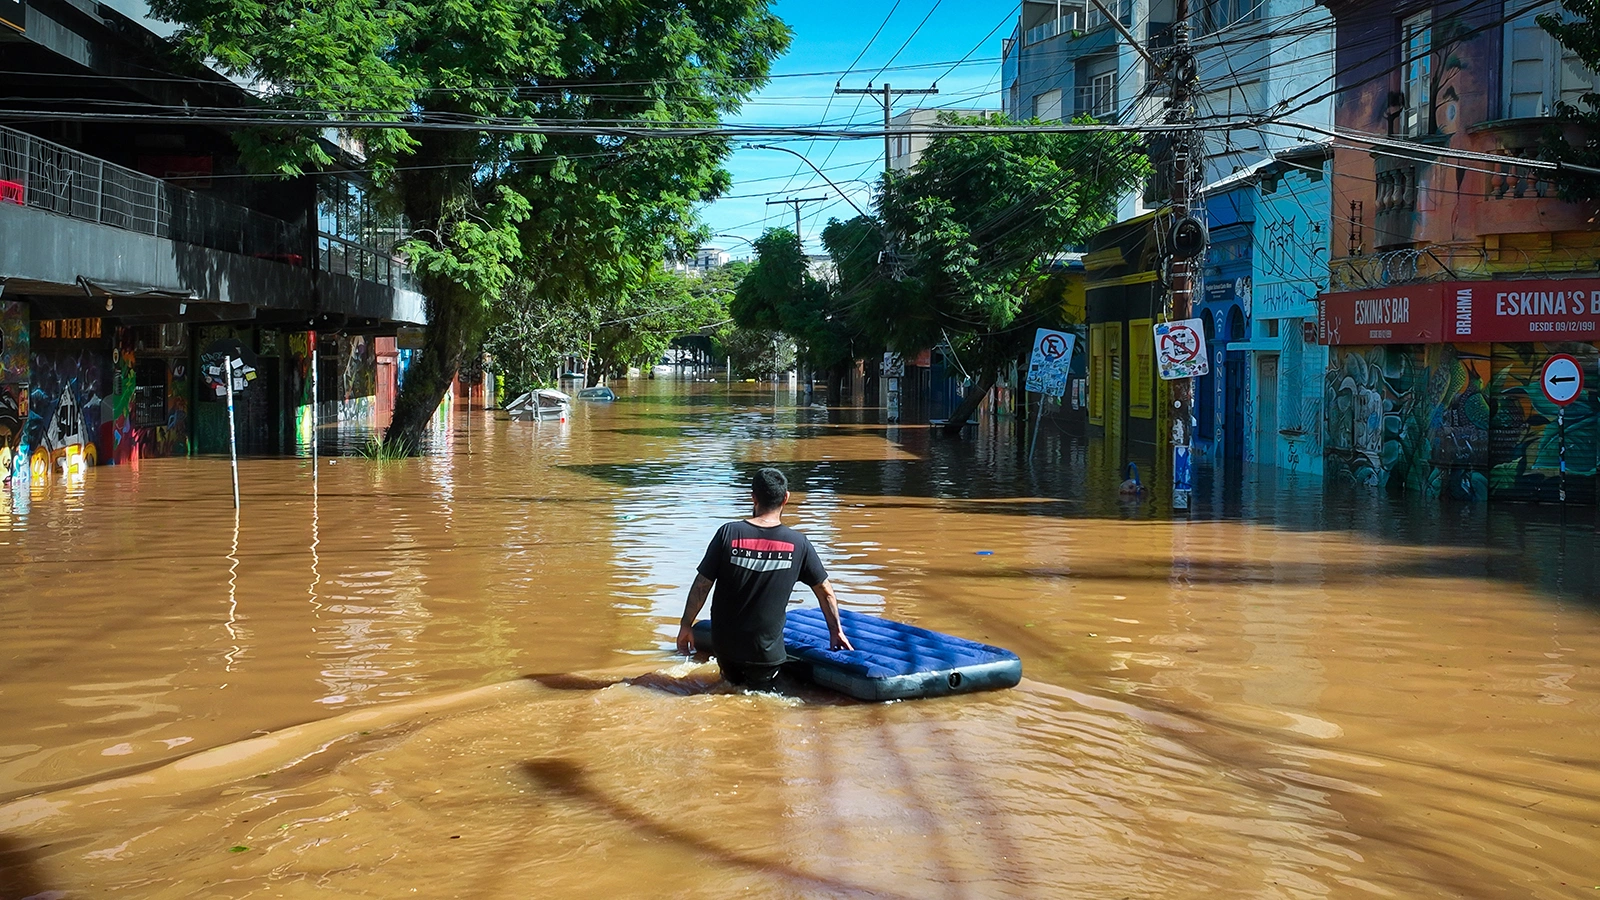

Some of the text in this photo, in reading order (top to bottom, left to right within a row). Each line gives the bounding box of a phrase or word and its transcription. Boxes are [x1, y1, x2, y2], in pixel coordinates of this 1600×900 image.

[1354, 297, 1410, 325] ESKINA'S BAR
[1456, 288, 1472, 335] BRAHMA
[1496, 291, 1585, 316] ESKINA'S
[1529, 321, 1596, 332] DESDE 09/12/1991
[731, 548, 793, 560] O'NEILL
